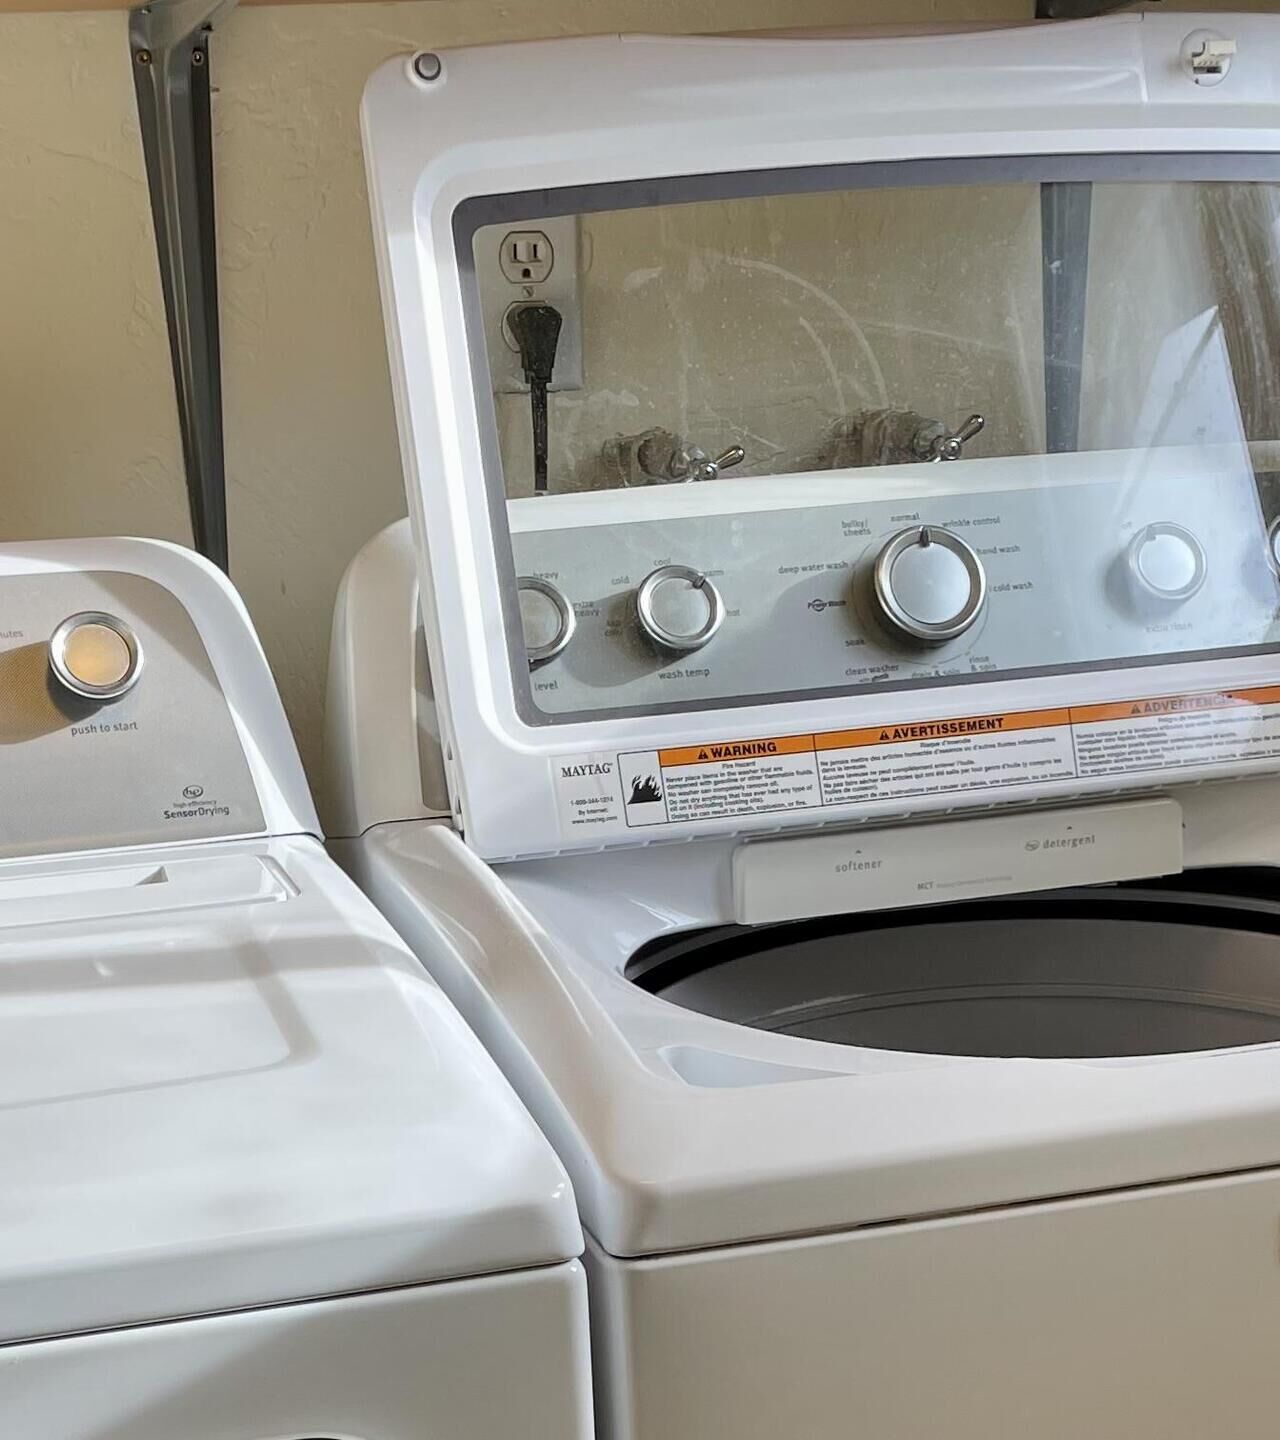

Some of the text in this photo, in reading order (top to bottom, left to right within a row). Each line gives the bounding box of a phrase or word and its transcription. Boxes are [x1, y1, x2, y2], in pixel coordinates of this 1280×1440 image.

[972, 515, 1001, 526] control
[778, 560, 849, 575] deep water wash
[1011, 581, 1034, 591] wash
[658, 667, 710, 680] wash temp
[534, 680, 559, 691] level
[1144, 692, 1237, 713] ADVERTENC
[71, 721, 138, 737] push to start
[892, 718, 1005, 740] AVERTISSEMENT
[710, 742, 777, 759] WARNING
[561, 763, 611, 778] MAYTAG
[164, 806, 230, 819] SensorDrying
[1043, 835, 1096, 850] detergent
[835, 858, 883, 873] softener
